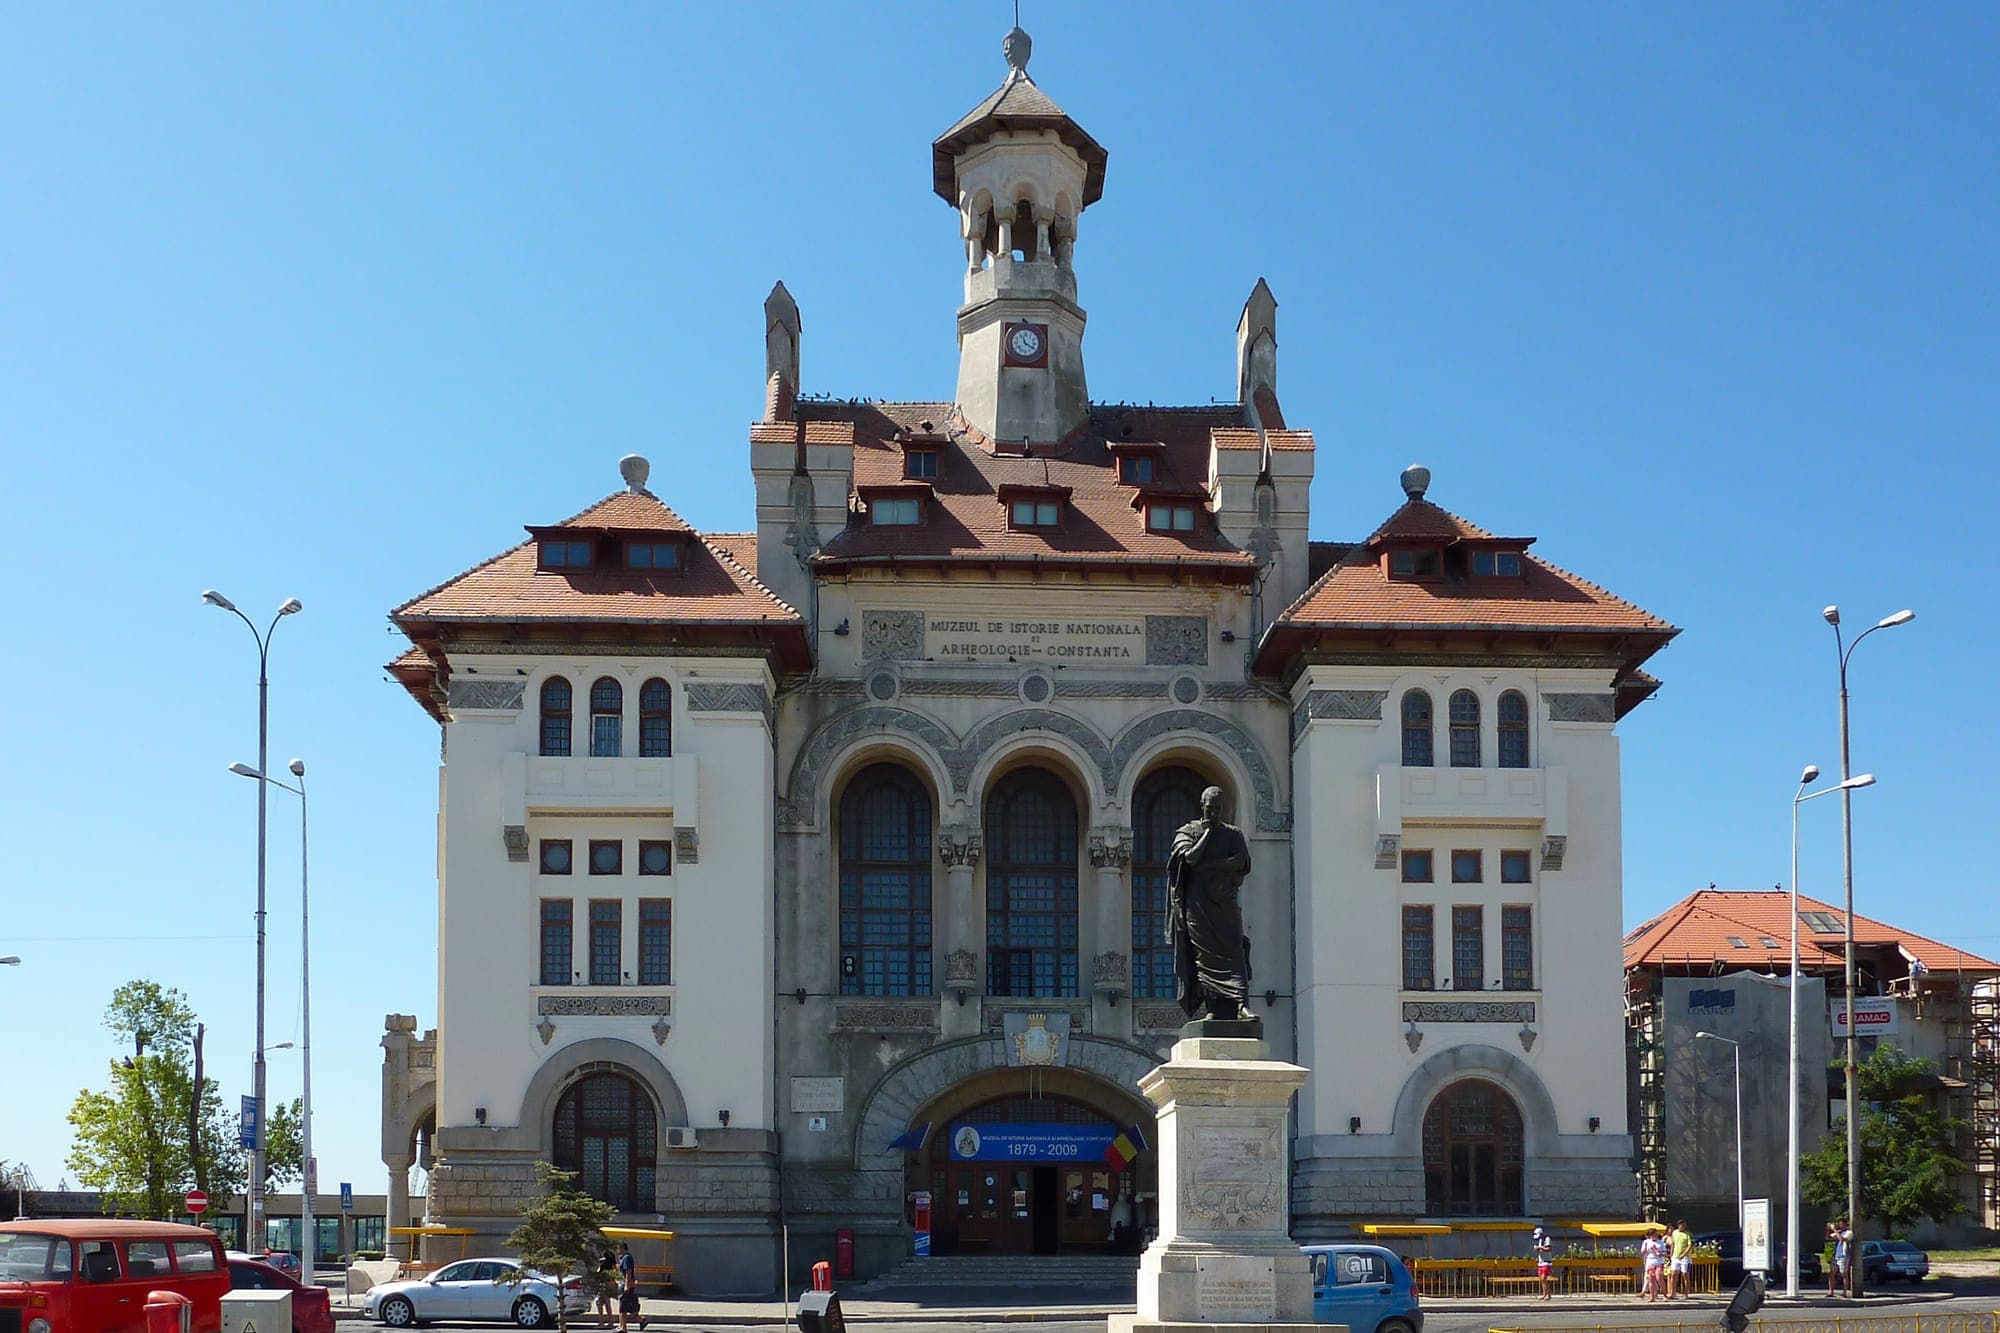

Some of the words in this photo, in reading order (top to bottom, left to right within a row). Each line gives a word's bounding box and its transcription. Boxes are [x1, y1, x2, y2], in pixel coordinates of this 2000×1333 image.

[931, 621, 981, 633] MUZEUL
[988, 622, 1003, 633] DE
[1010, 622, 1060, 634] ISTORIE
[1066, 623, 1141, 635] NATIONALA
[1047, 645, 1130, 657] CONSTANTA
[1008, 1143, 1037, 1156] 1879
[1047, 1143, 1078, 1156] 2009
